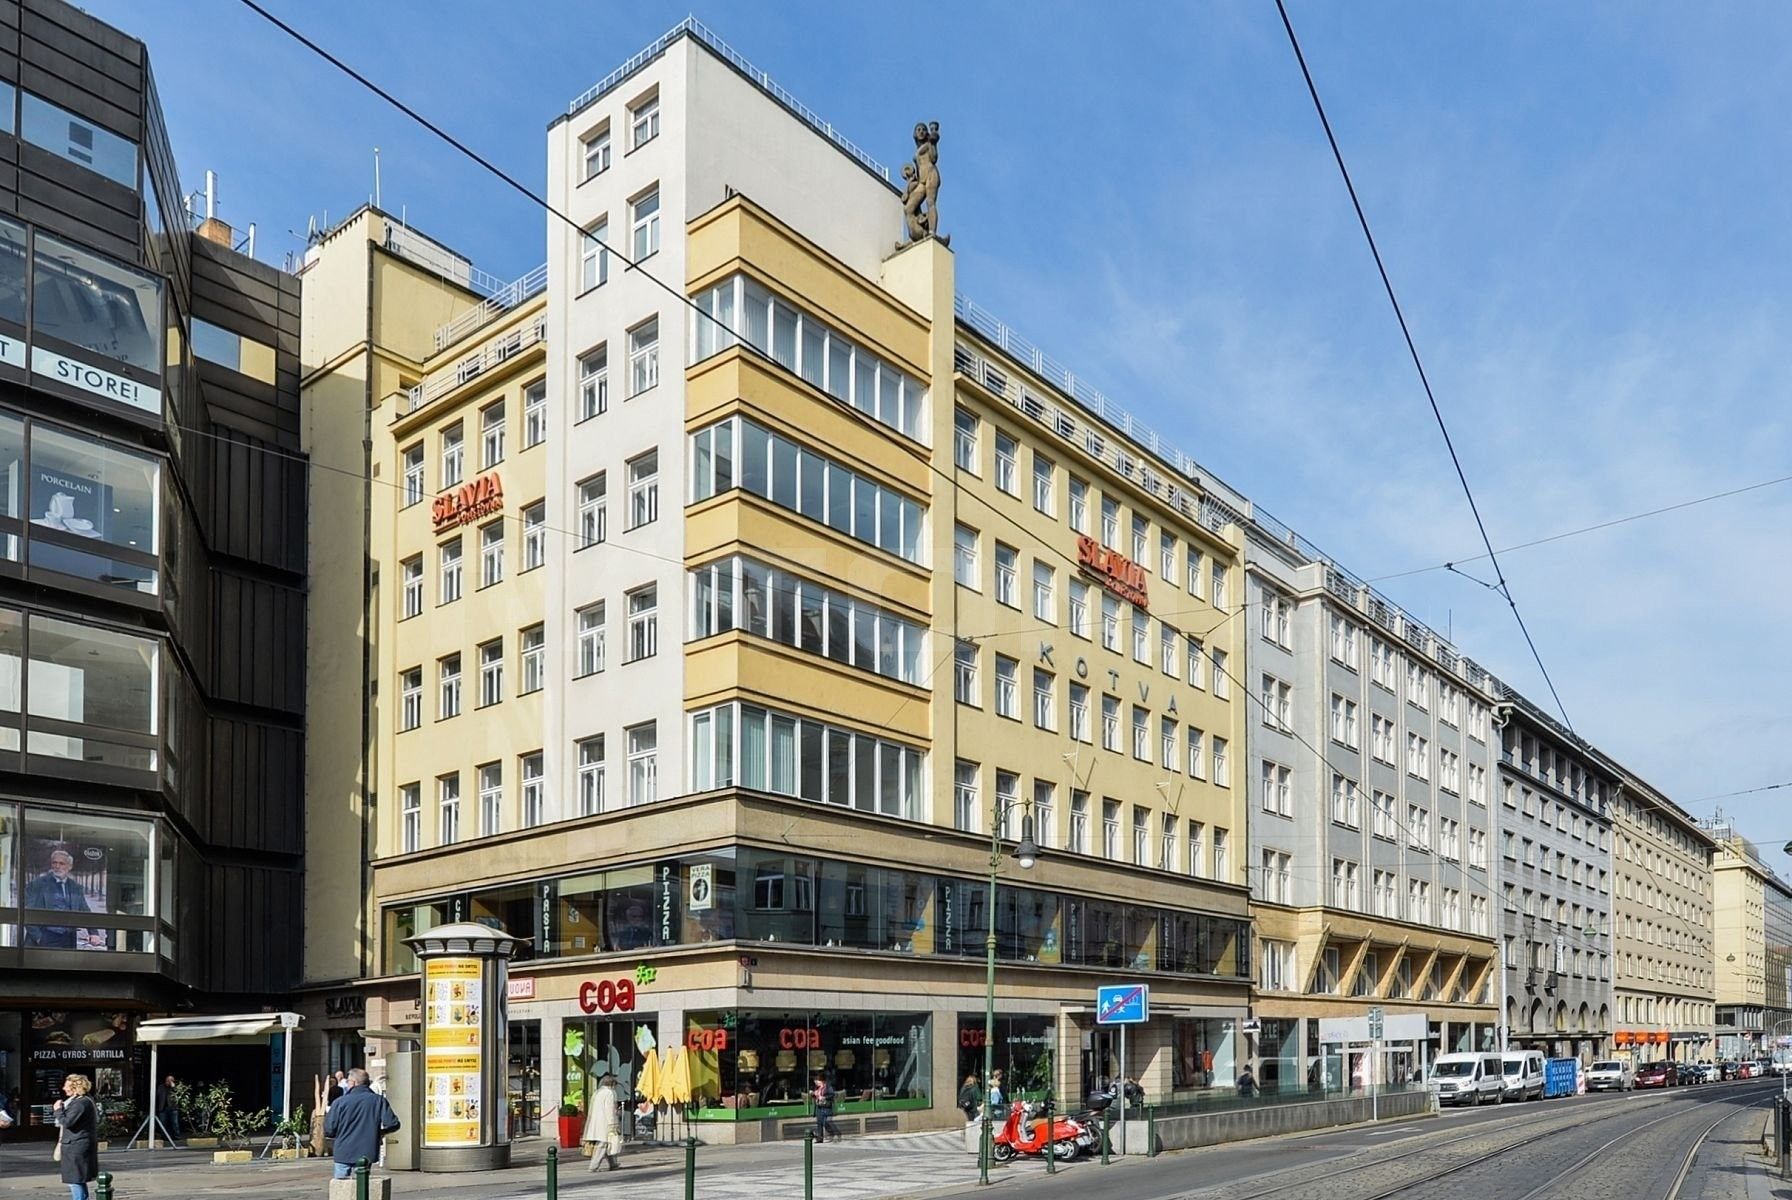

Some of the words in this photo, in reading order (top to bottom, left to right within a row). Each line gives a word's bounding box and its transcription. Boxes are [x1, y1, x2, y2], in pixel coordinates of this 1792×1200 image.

[57, 360, 139, 401] STORE!
[40, 473, 92, 495] PORCELAIN
[432, 471, 503, 524] SLAVIA
[1077, 535, 1147, 594] SLAVIA
[1040, 640, 1178, 715] KOTVA
[662, 866, 670, 940] PIZZA
[579, 978, 636, 1014] coa
[34, 1050, 56, 1059] PIZZA
[62, 1050, 87, 1059] GYROS
[93, 1049, 125, 1059] TORTILLA
[688, 1028, 728, 1051] coa
[780, 1028, 819, 1049] coa
[842, 1035, 860, 1045] asian
